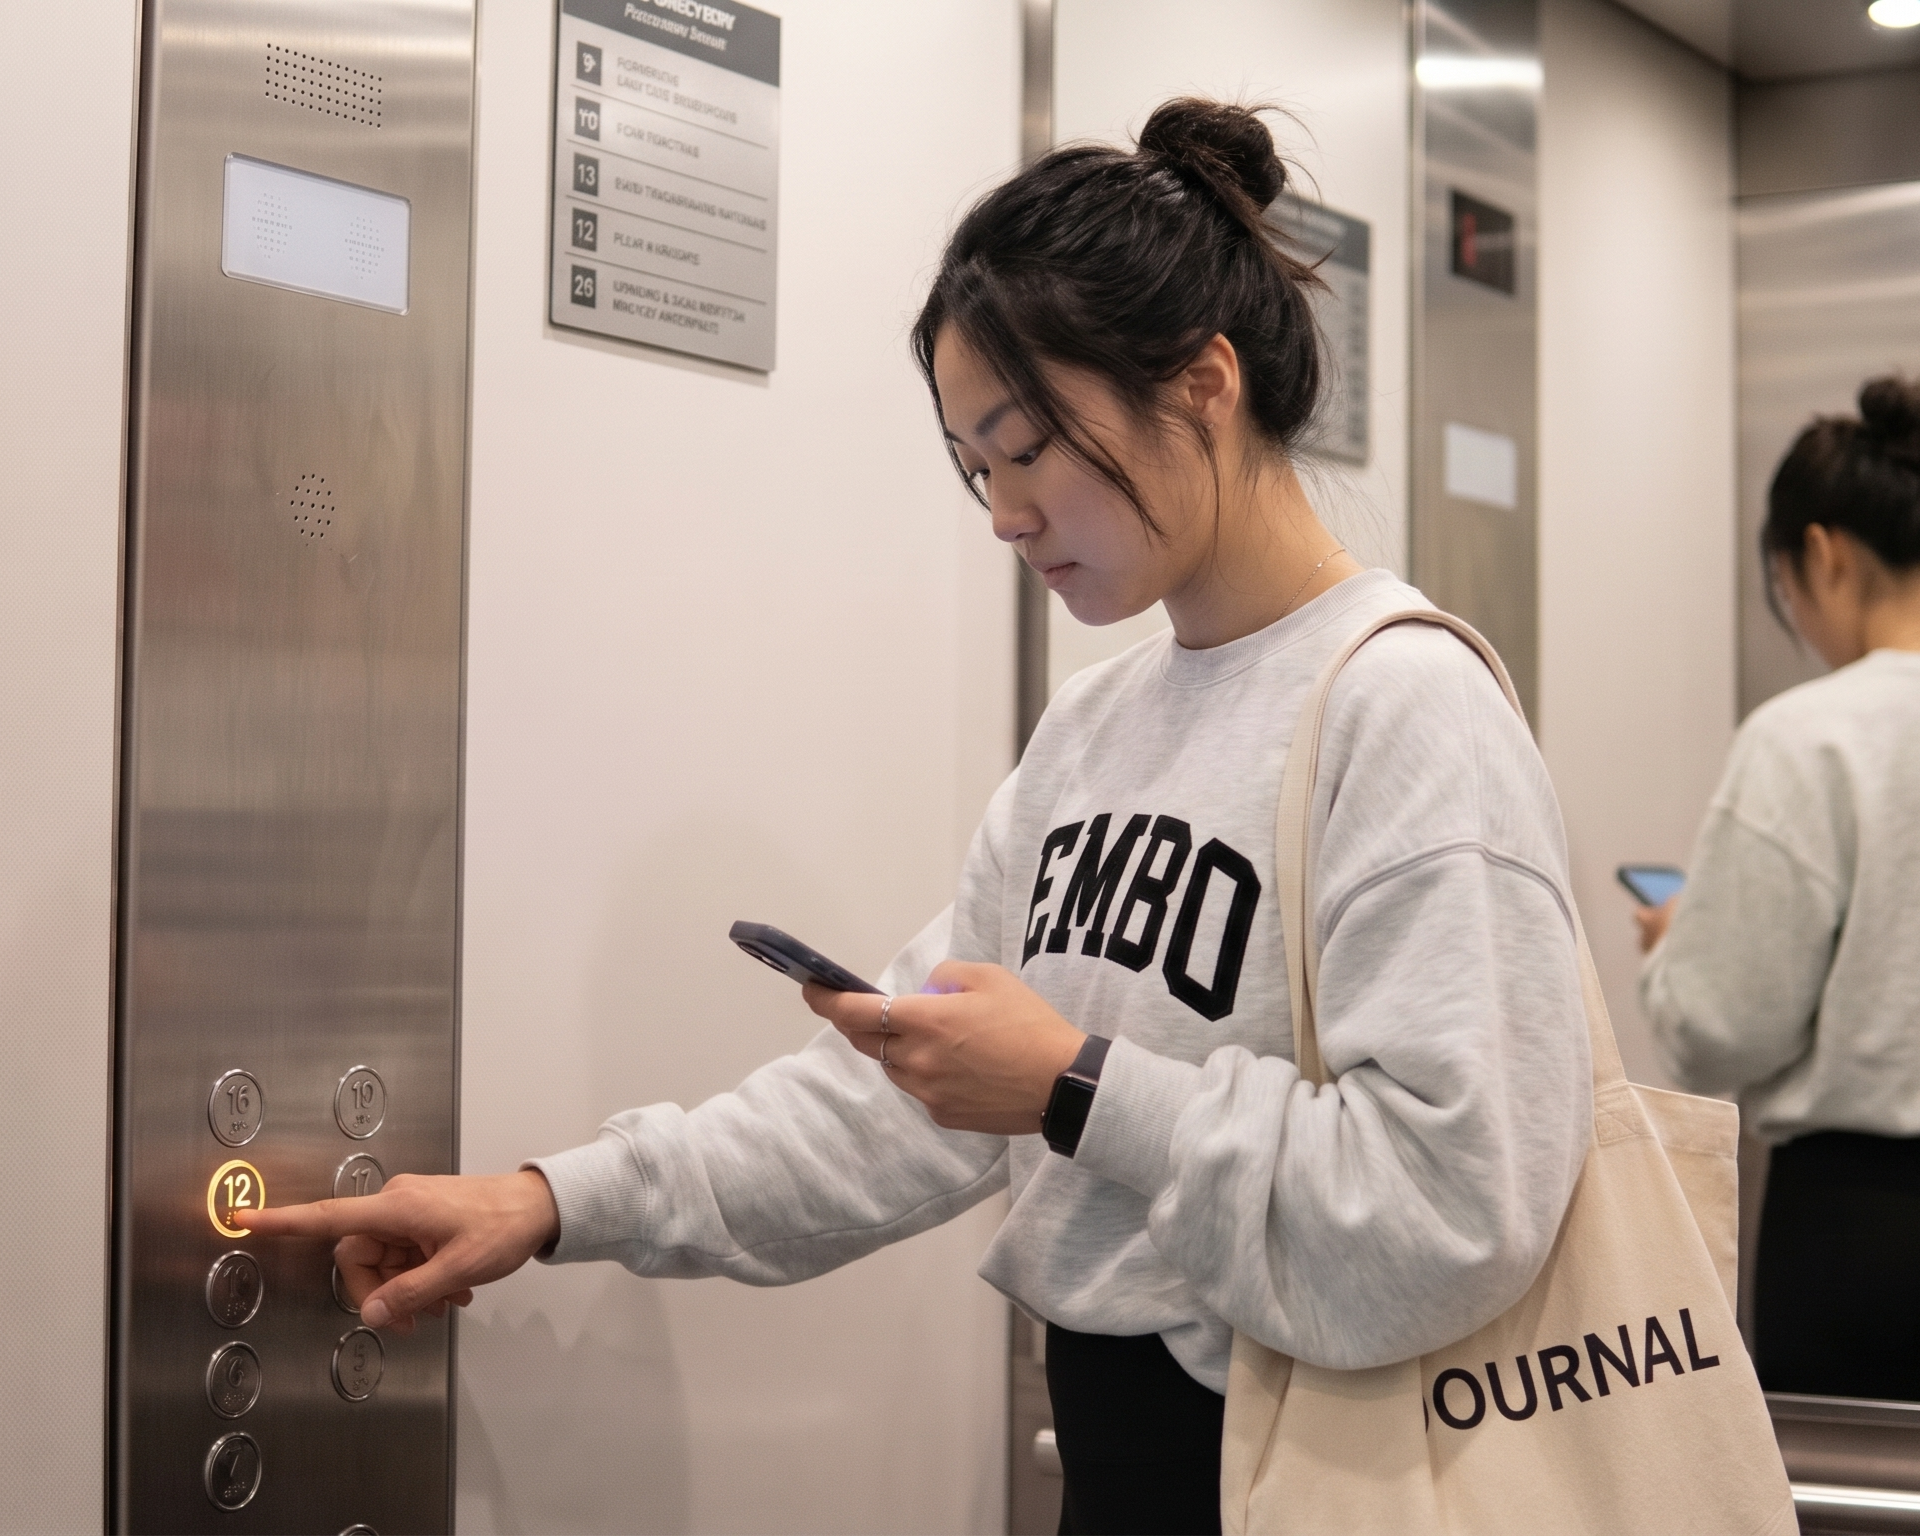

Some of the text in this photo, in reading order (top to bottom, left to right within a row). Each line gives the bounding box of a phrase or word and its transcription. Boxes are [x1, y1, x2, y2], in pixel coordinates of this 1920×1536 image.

[578, 163, 596, 186] 13
[576, 218, 594, 242] 12
[574, 275, 594, 298] 26
[1020, 813, 1261, 1022] EMBO
[227, 1084, 250, 1115] 16
[223, 1173, 251, 1207] 12
[1422, 1307, 1720, 1434] OURNAL
